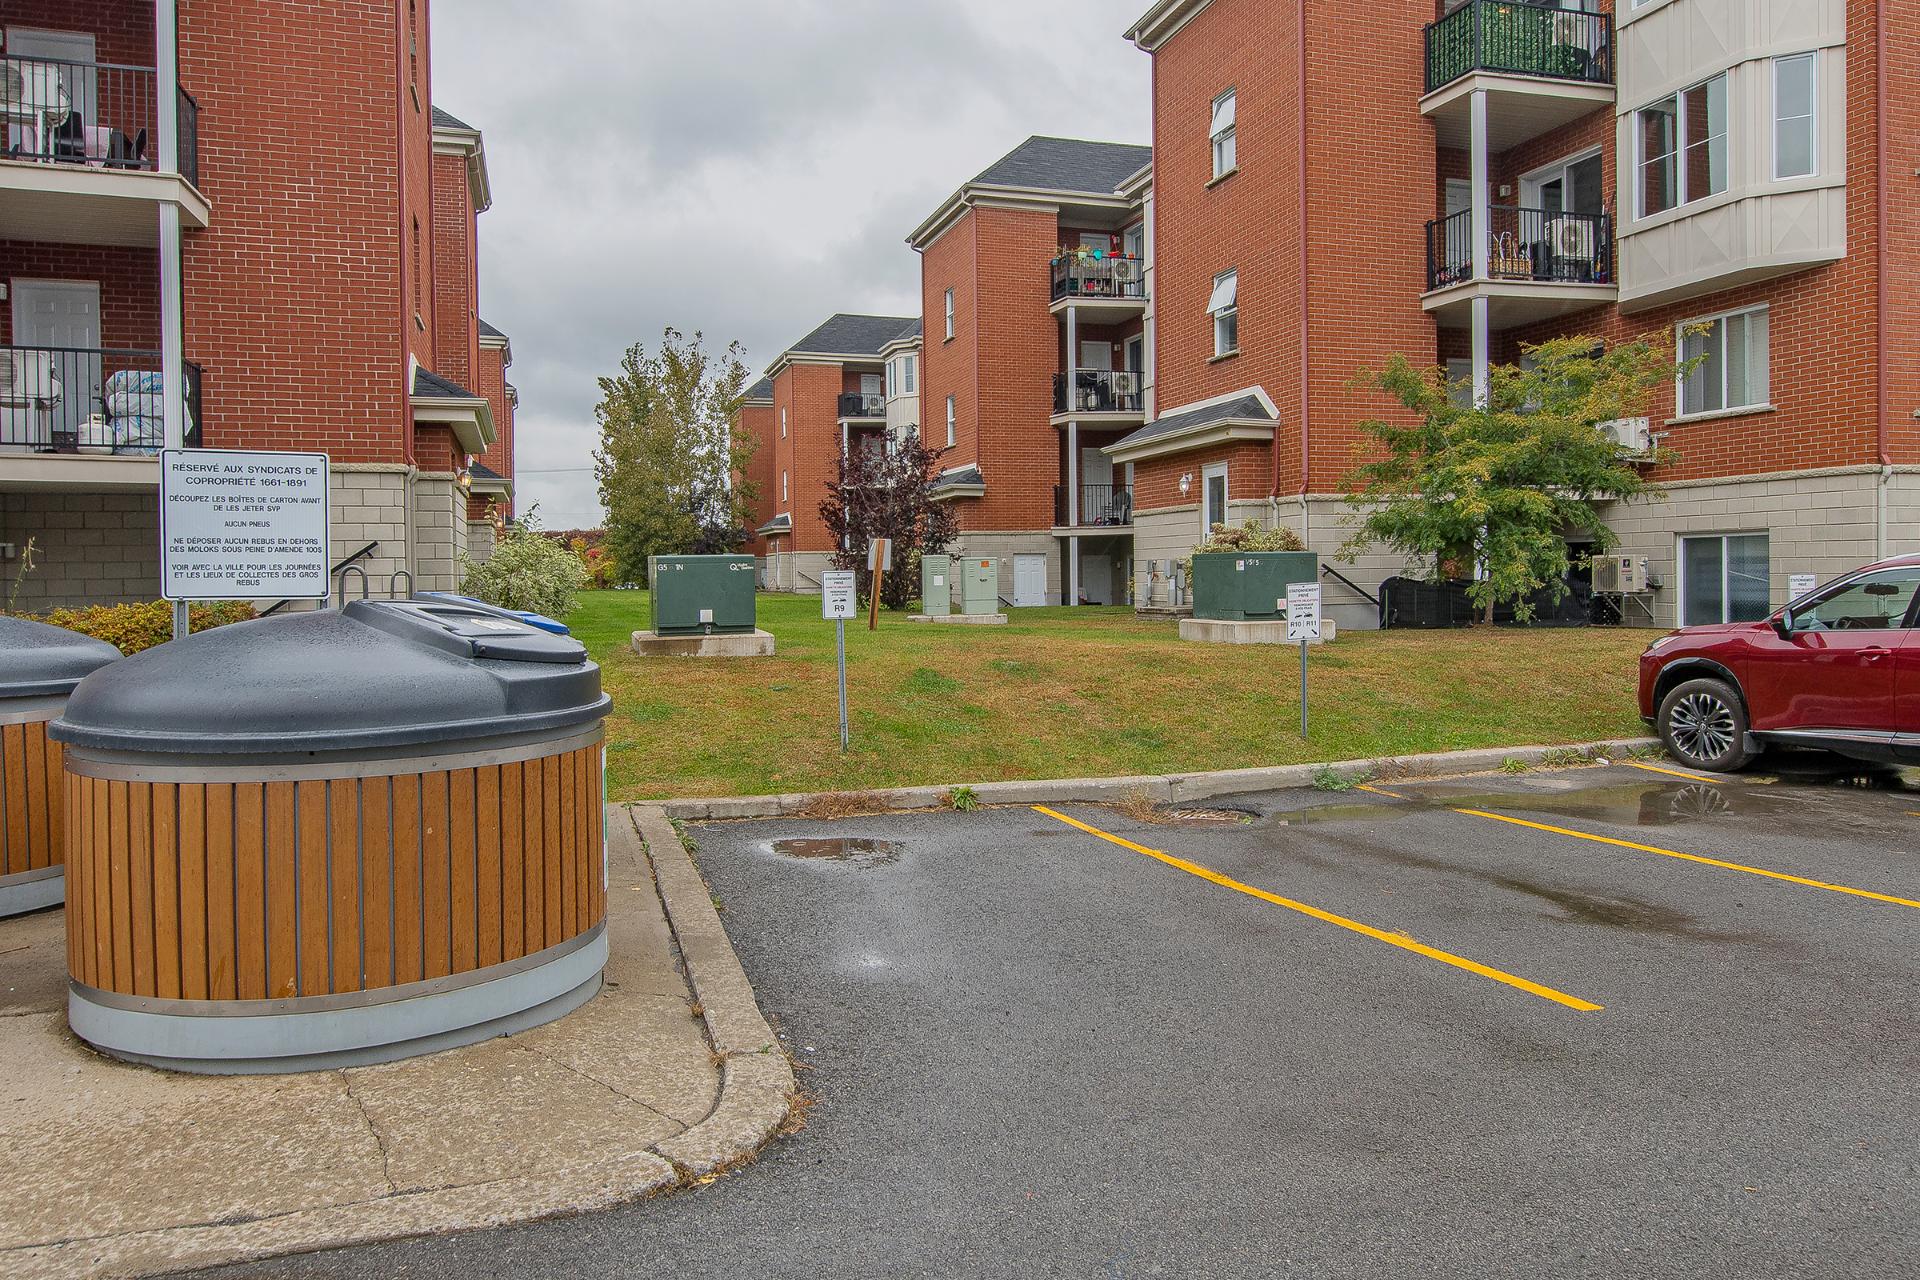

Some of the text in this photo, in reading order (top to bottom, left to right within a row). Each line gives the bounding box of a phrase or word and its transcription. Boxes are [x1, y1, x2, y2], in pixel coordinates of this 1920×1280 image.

[172, 462, 220, 472] RÉSERVÉ
[224, 465, 243, 473] AUX
[248, 465, 302, 474] SYNDICATS
[185, 476, 307, 487] COPROPRIÉTÉ 1661-1891
[169, 494, 209, 502] DÉCOUPEZ
[228, 494, 255, 503] BOÎTES
[270, 496, 298, 504] CARTON
[187, 536, 221, 545] DÉPOSER
